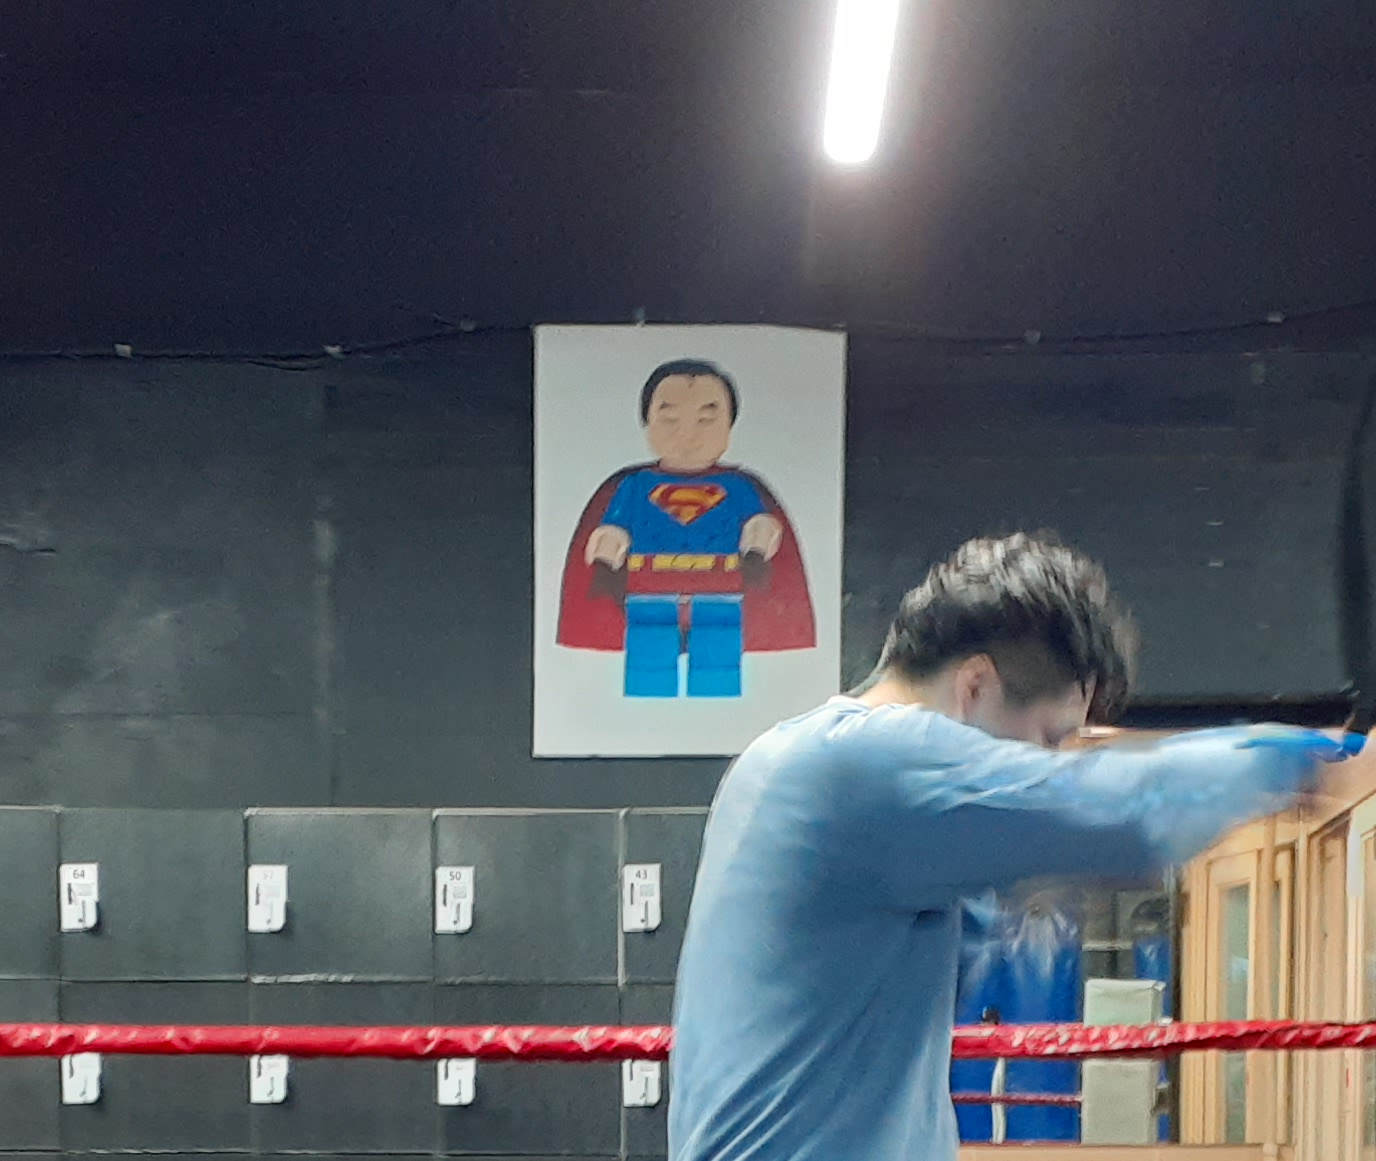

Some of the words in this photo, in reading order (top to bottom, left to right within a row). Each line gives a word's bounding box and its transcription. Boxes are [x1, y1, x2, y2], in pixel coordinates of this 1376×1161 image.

[72, 868, 86, 880] 64
[448, 870, 462, 882] 50
[635, 868, 648, 880] 43
